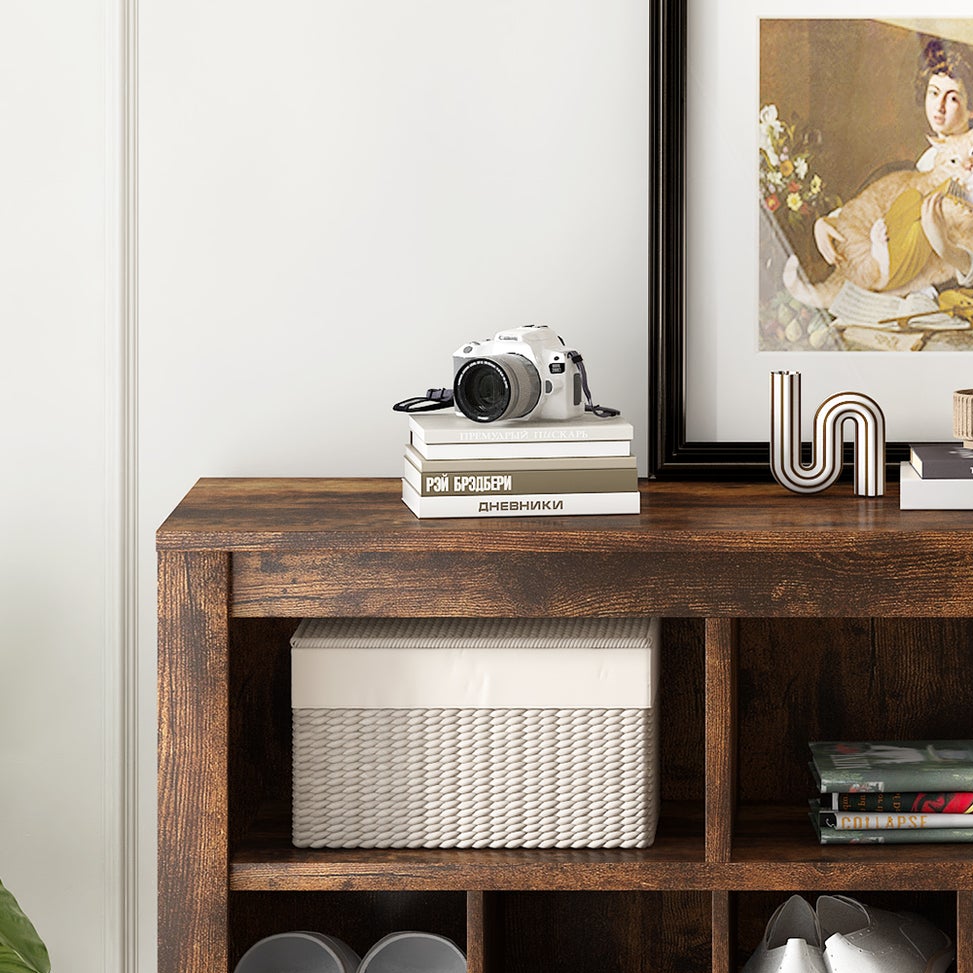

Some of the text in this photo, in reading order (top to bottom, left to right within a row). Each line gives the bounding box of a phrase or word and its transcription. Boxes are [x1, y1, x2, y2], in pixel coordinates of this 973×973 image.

[426, 473, 512, 493] РЭЙ БРЭДБЕРИ
[478, 500, 563, 513] ДНЕВНИКИ
